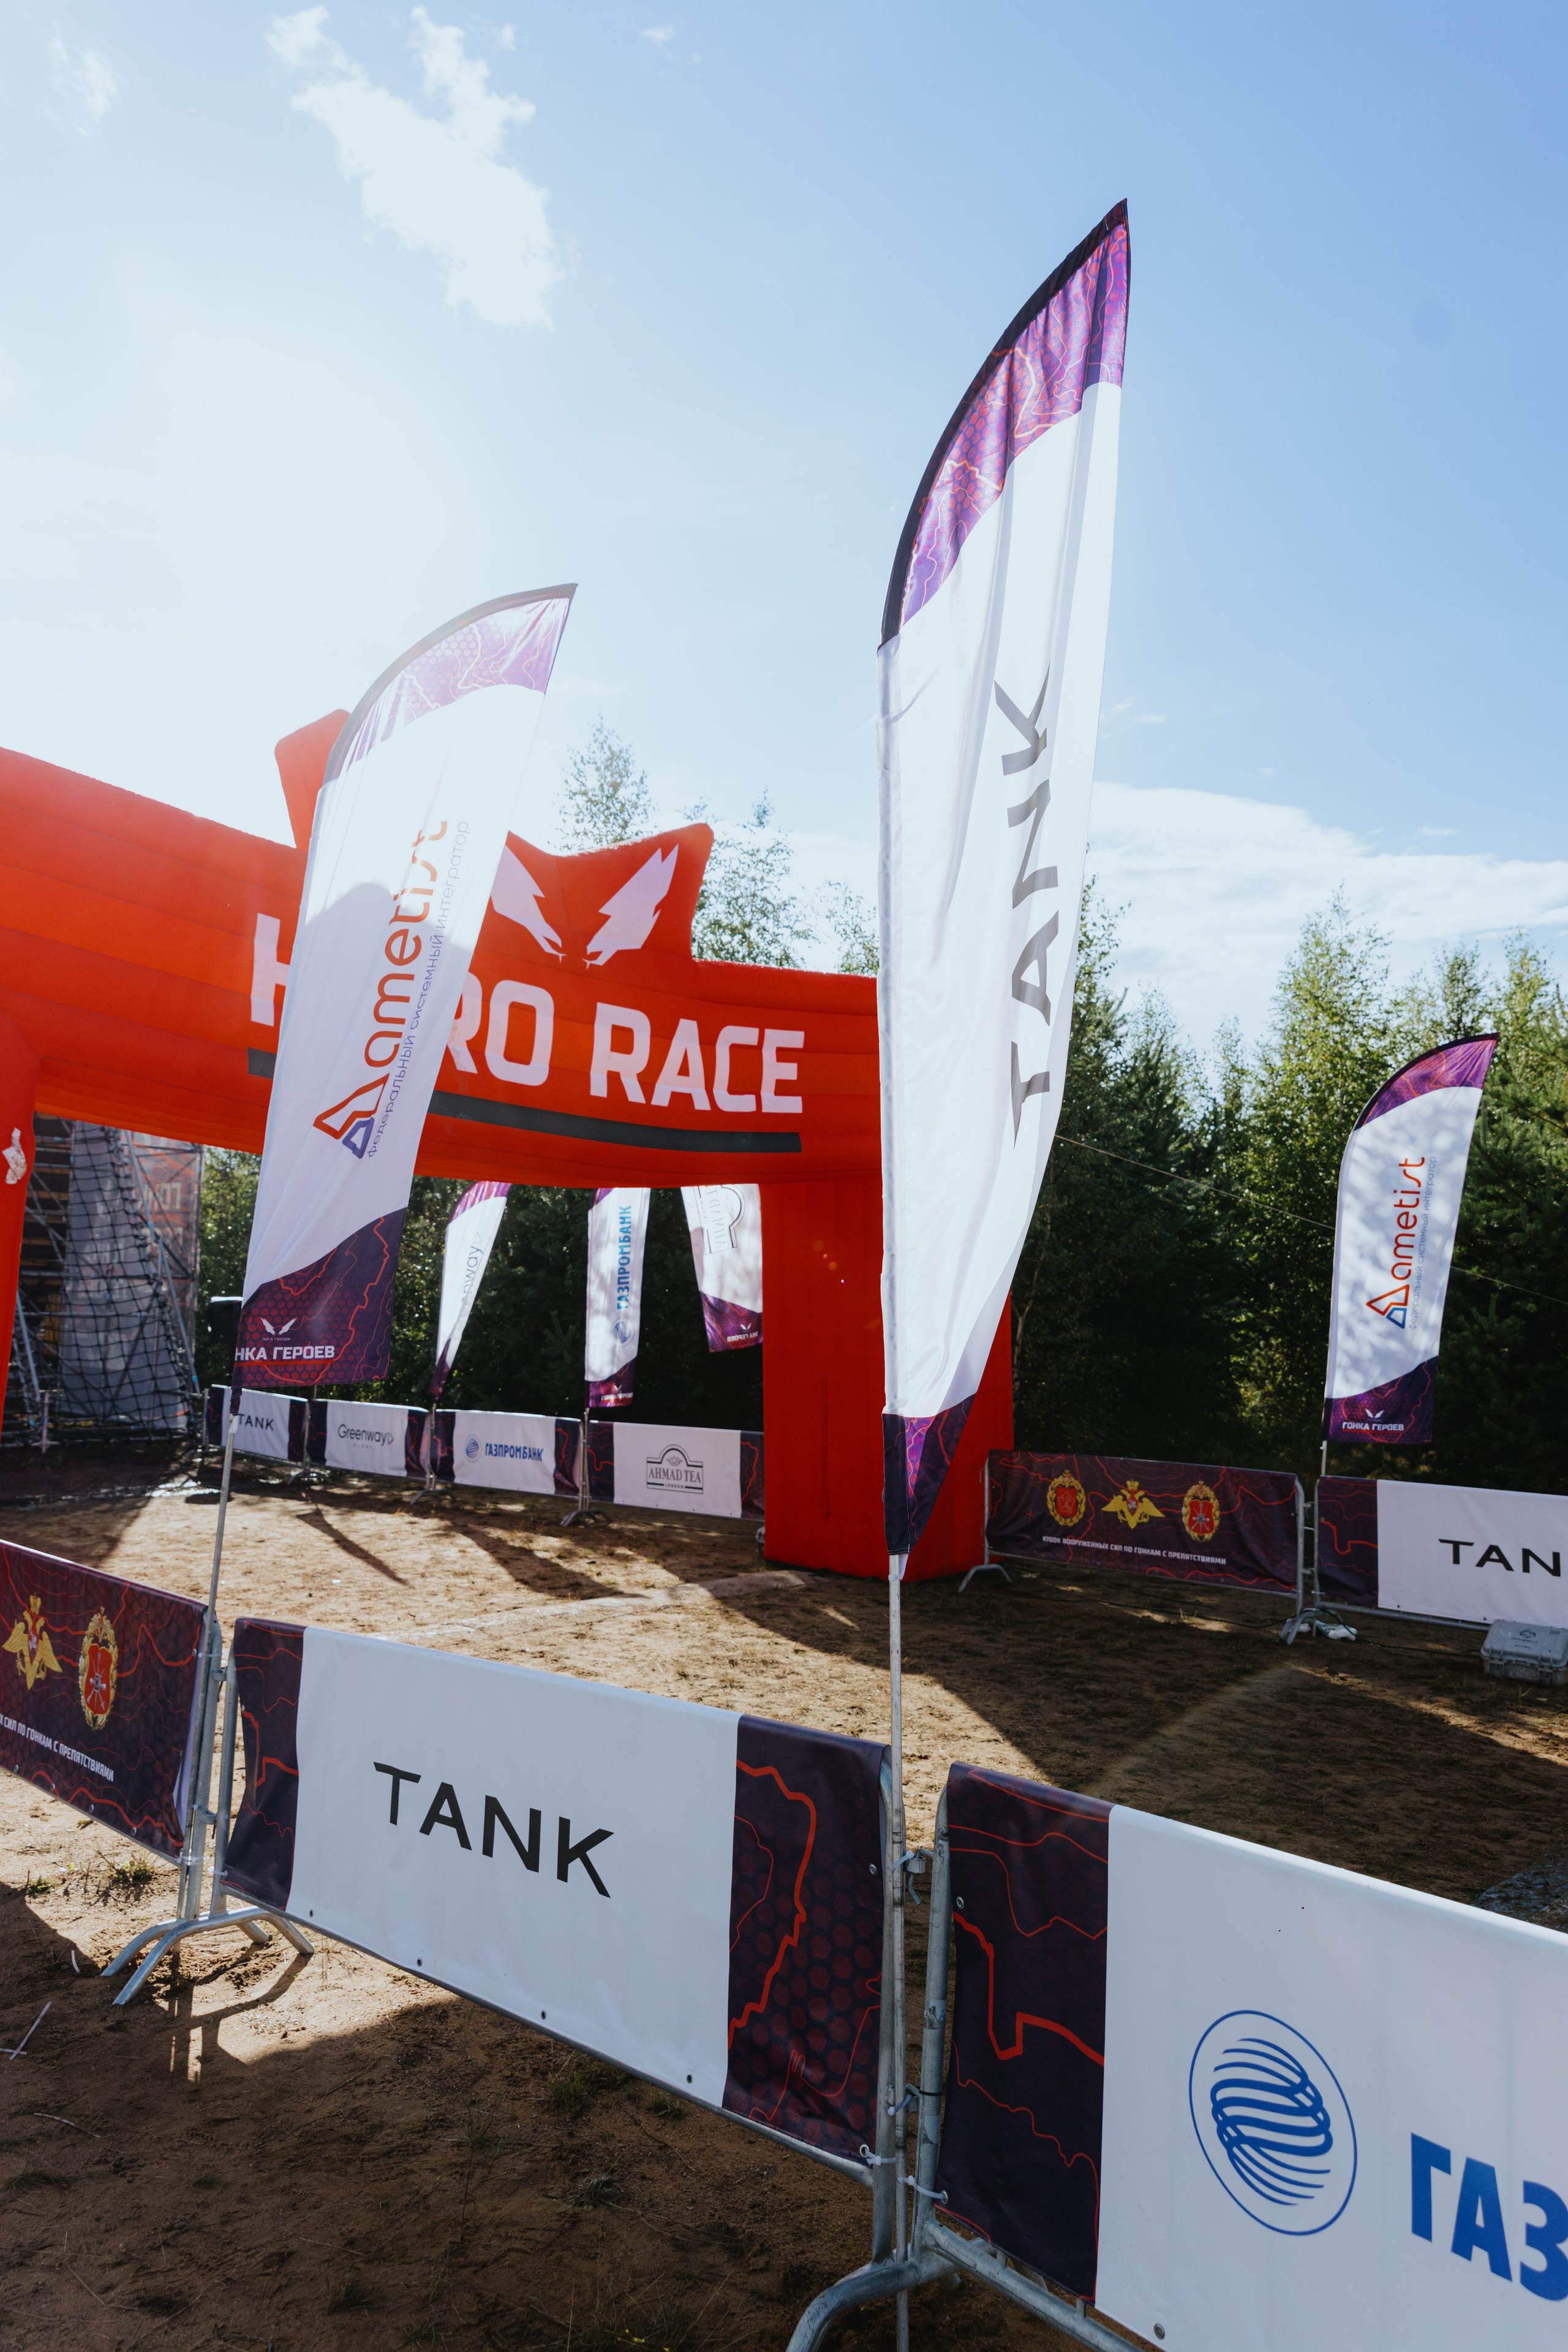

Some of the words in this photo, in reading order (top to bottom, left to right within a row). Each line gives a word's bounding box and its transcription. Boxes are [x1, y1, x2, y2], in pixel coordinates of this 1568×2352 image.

[364, 820, 447, 1069] ametist
[993, 658, 1059, 1150] TANK
[250, 912, 554, 1088] HRO
[590, 1001, 806, 1114] RACE
[367, 1035, 416, 1158] федеральный
[410, 935, 445, 1030] системный
[435, 820, 470, 930] интегратор
[616, 1205, 632, 1310] ГАЗПРОМБАНК
[1390, 1156, 1425, 1281] ametist
[1408, 1265, 1423, 1331] федеральный
[1417, 1213, 1429, 1264] системный
[1423, 1156, 1438, 1211] интегратор
[273, 1345, 336, 1360] ГЕРОЕВ
[238, 1413, 274, 1431] TANK
[337, 1424, 388, 1446] Greenway
[484, 1442, 544, 1461] ГАЗПРОМБАНК
[1342, 1422, 1370, 1430] ГОНКА
[1371, 1423, 1404, 1431] ГЕРОЕВ
[649, 1466, 682, 1481] AHMAD
[683, 1469, 701, 1483] TEA
[1062, 1538, 1109, 1550] ВООРУЖЕННЫХ
[1134, 1547, 1161, 1557] ГОНКАМ
[1168, 1551, 1227, 1566] ПРЕПЯТСТВИЯМИ
[4, 1716, 17, 1732] СИЛ
[17, 1722, 26, 1736] ПО
[26, 1727, 53, 1751] ГОНКАМ
[53, 1740, 59, 1753] С
[59, 1743, 115, 1782] ПРЕПЯТСТВИЯМИ
[373, 1761, 614, 1899] TANK
